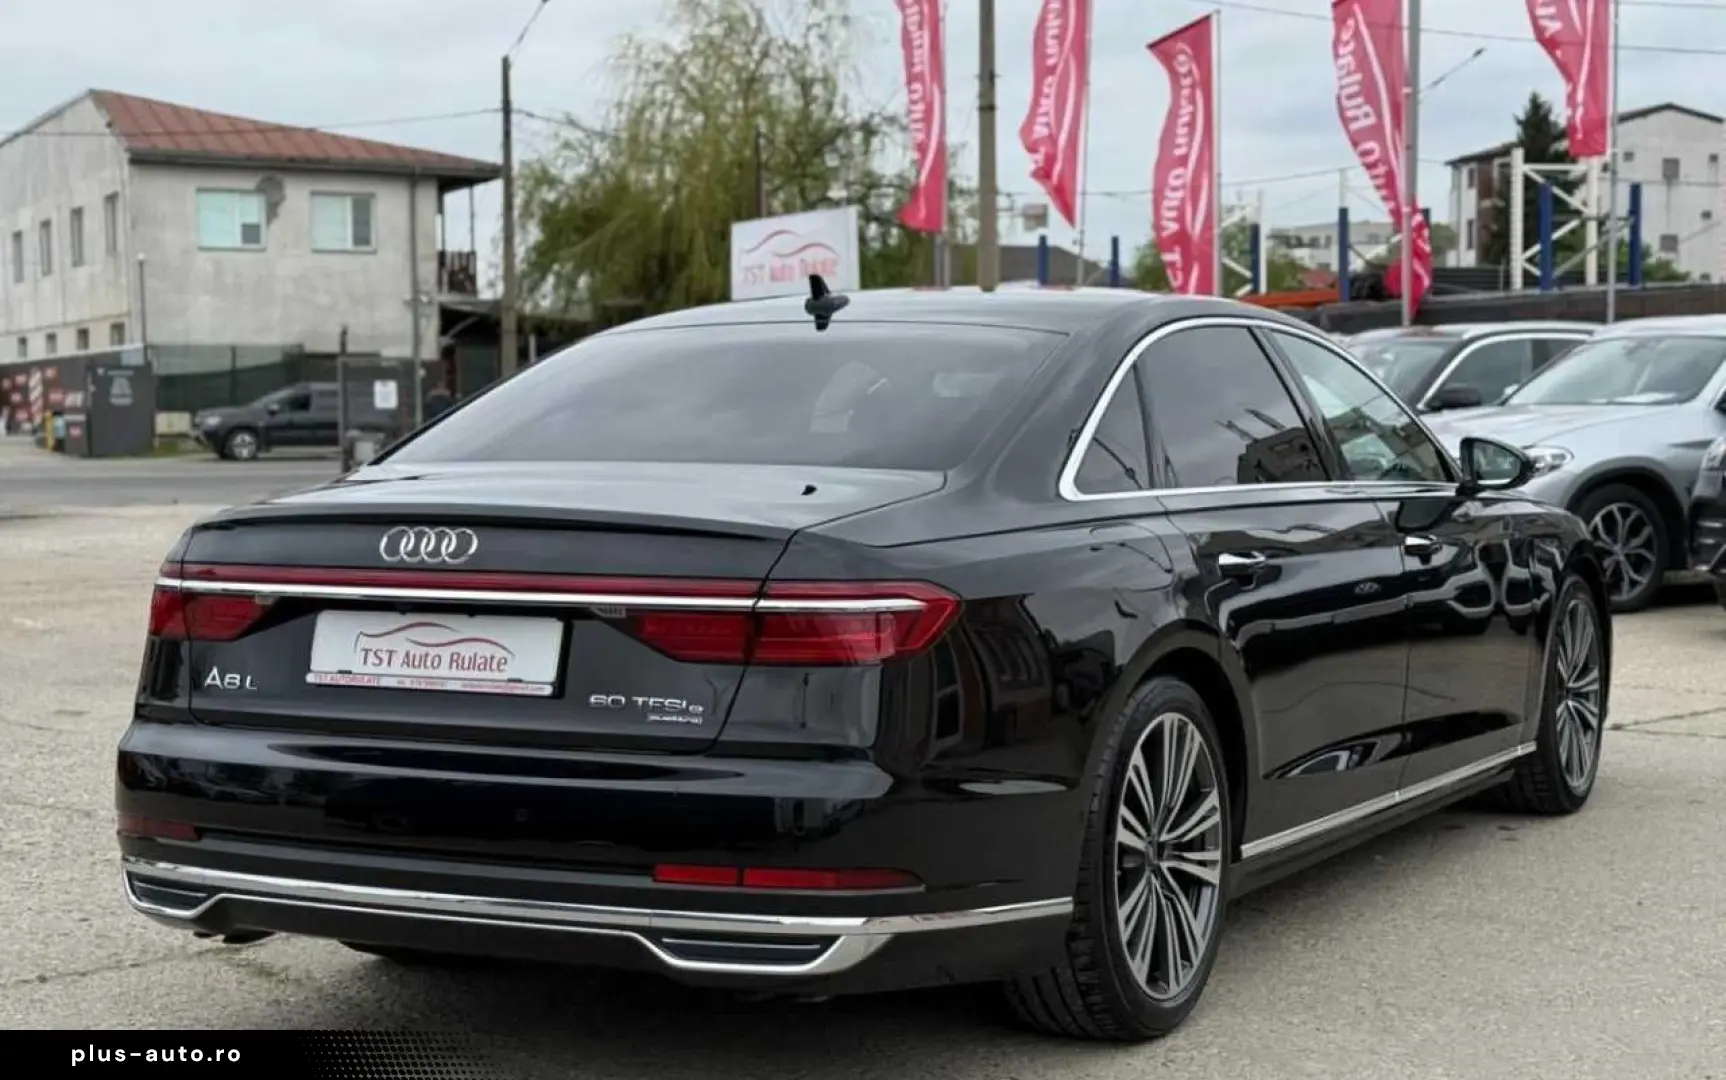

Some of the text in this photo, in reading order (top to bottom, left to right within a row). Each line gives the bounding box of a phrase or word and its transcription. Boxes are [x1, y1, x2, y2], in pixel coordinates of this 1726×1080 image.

[361, 648, 508, 673] TST Auto Rulate
[204, 665, 258, 691] A8 L
[590, 694, 626, 709] 60
